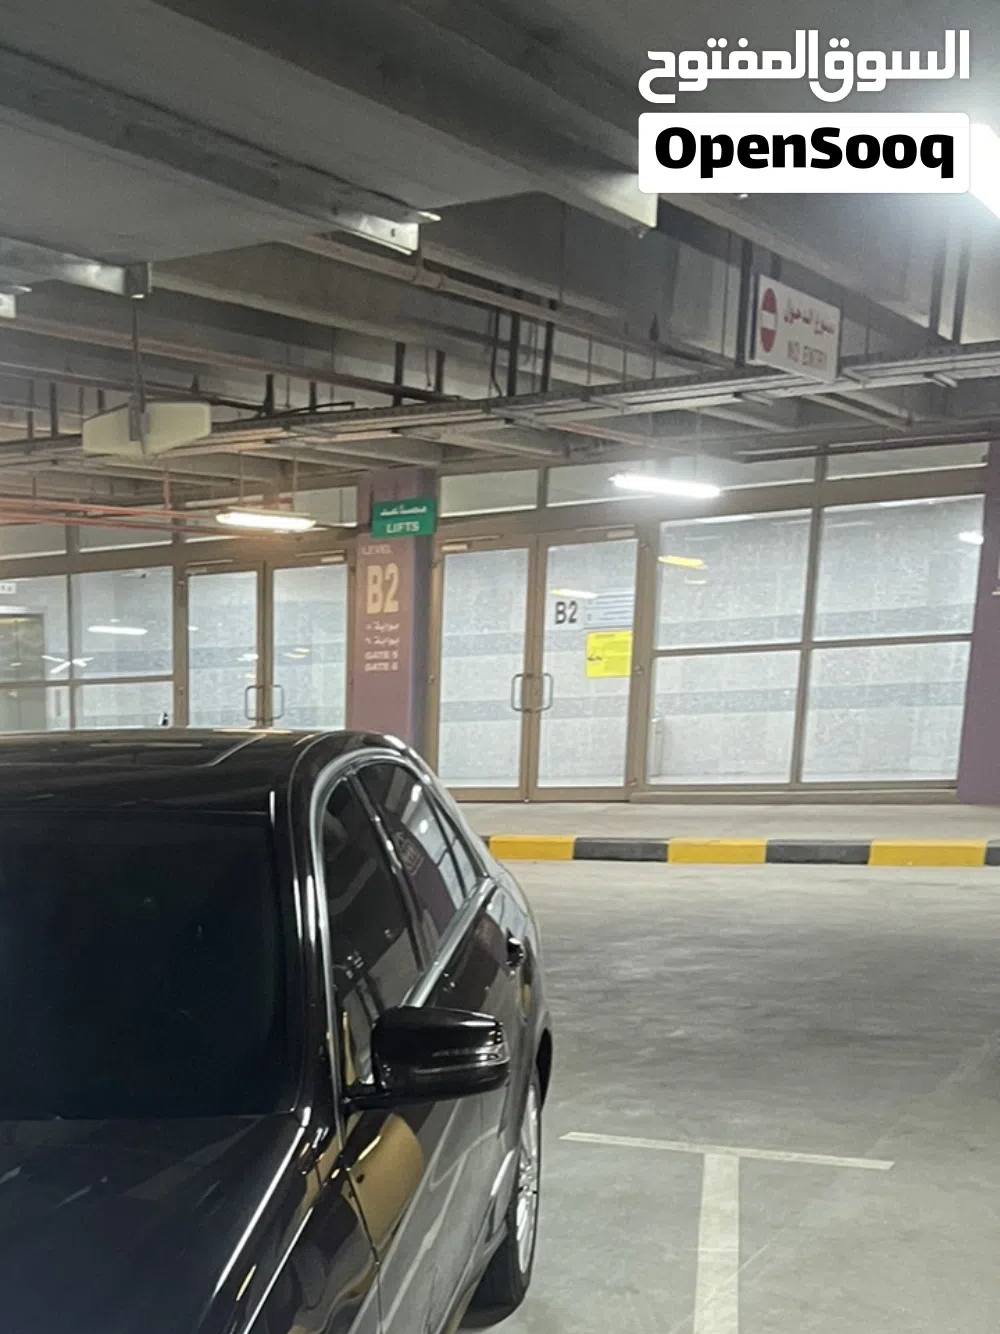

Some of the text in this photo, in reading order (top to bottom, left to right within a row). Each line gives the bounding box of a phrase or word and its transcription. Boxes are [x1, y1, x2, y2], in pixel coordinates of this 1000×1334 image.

[386, 521, 420, 534] LIFTS
[363, 544, 391, 555] LEVEL
[366, 563, 399, 615] B2
[555, 601, 578, 624] B2
